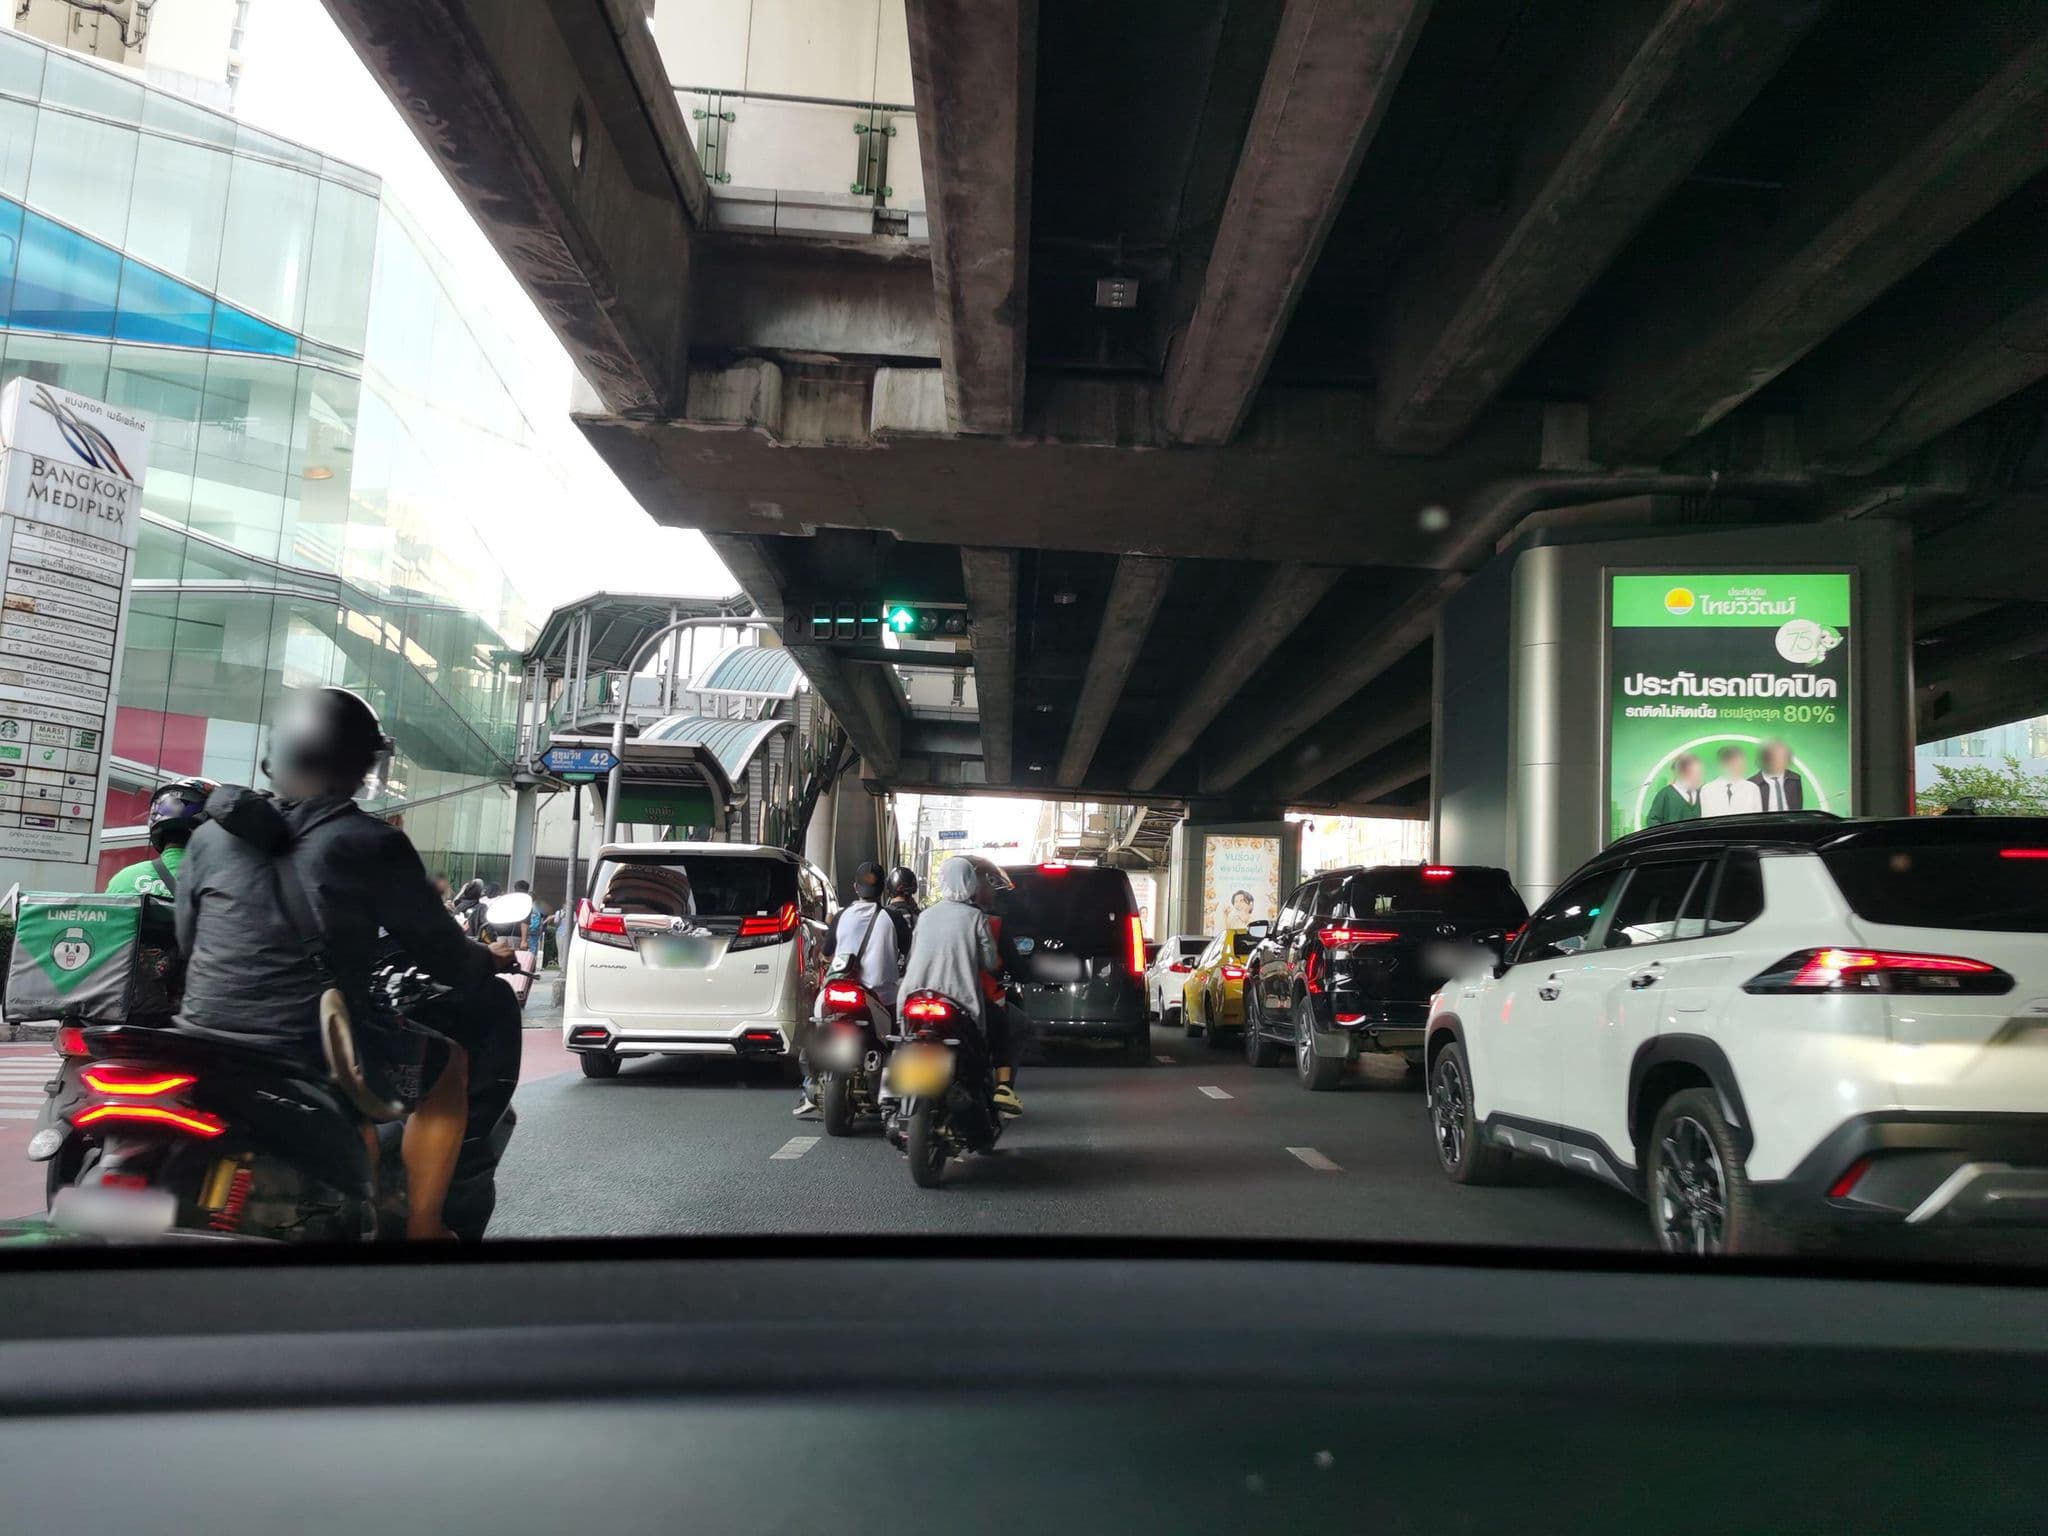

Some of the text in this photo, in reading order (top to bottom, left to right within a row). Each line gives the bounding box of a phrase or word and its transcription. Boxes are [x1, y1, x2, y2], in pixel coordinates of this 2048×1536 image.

[32, 456, 128, 504] BANGKOK
[27, 481, 125, 526] MEDIPLEX
[1699, 594, 1797, 615] ไทยวิวัฒน์
[1624, 671, 1837, 698] ประกันรถเปิดปิด
[1625, 703, 1716, 719] รถติดไม่คิดเบี้ย
[589, 752, 609, 766] 42
